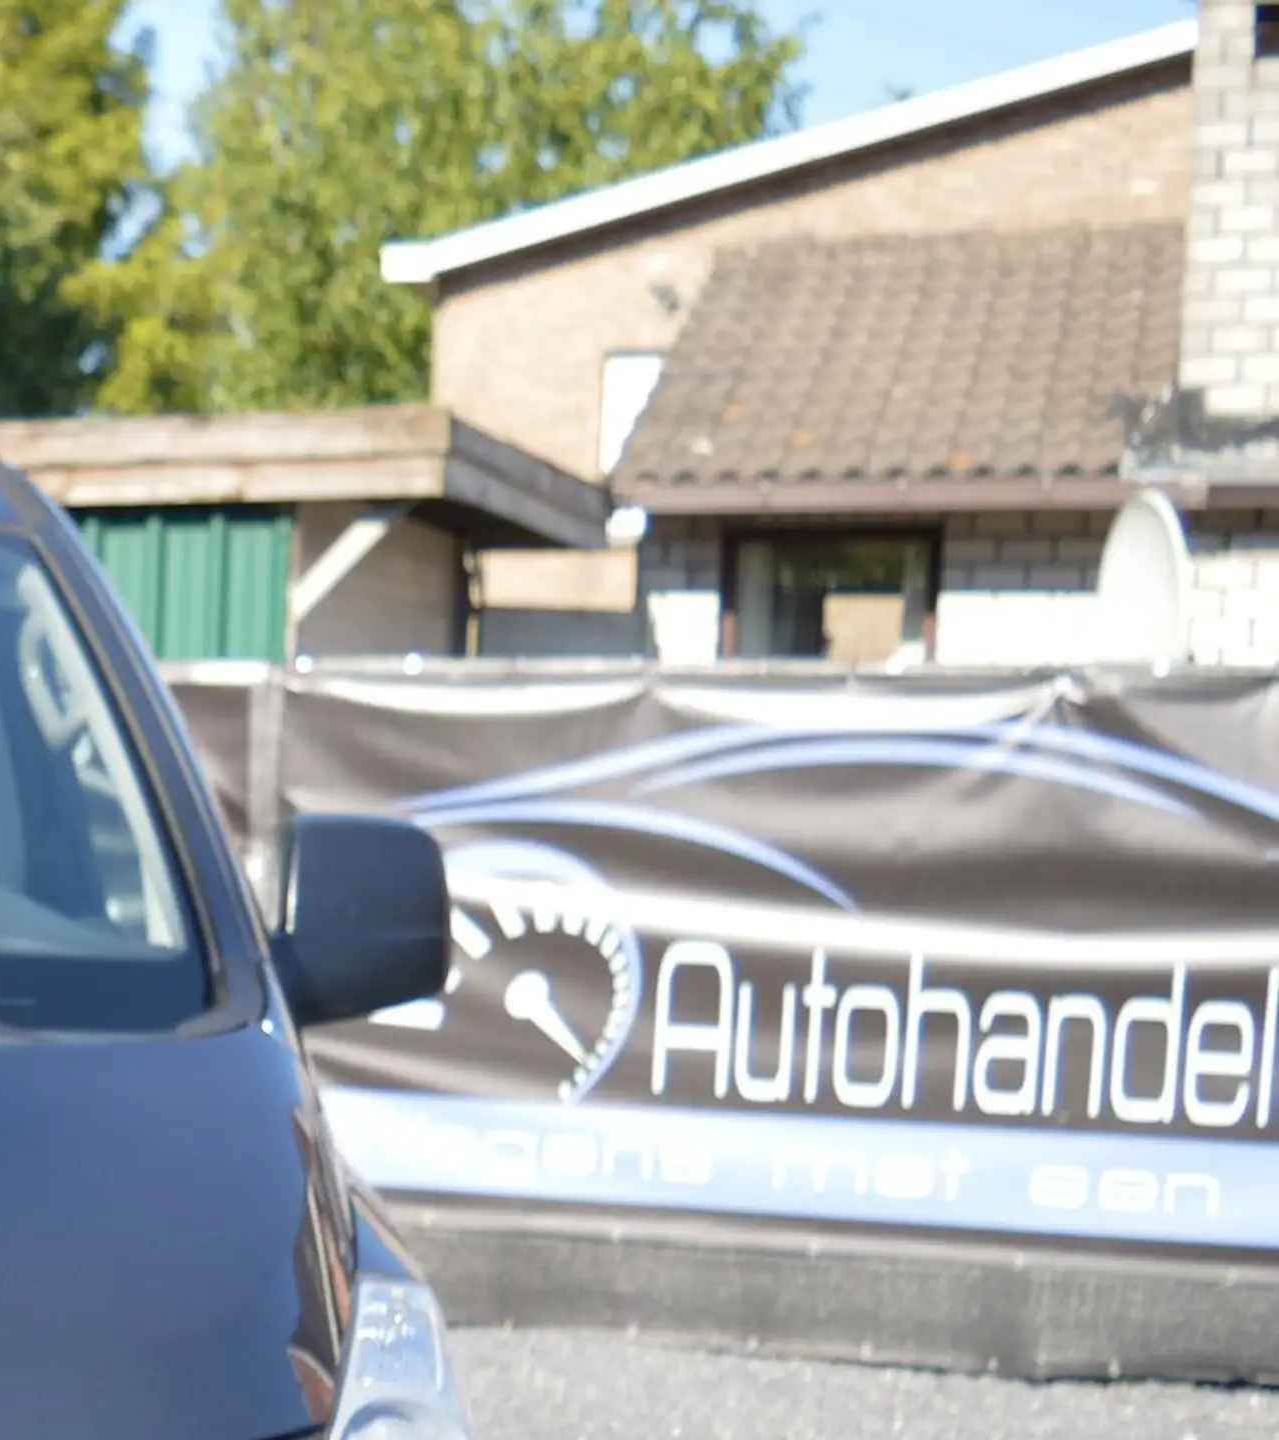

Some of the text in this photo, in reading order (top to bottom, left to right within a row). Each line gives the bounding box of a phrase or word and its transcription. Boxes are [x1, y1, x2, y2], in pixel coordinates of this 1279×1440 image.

[651, 941, 1279, 1129] Autohandel
[771, 1140, 974, 1201] met
[1028, 1162, 1222, 1219] een
